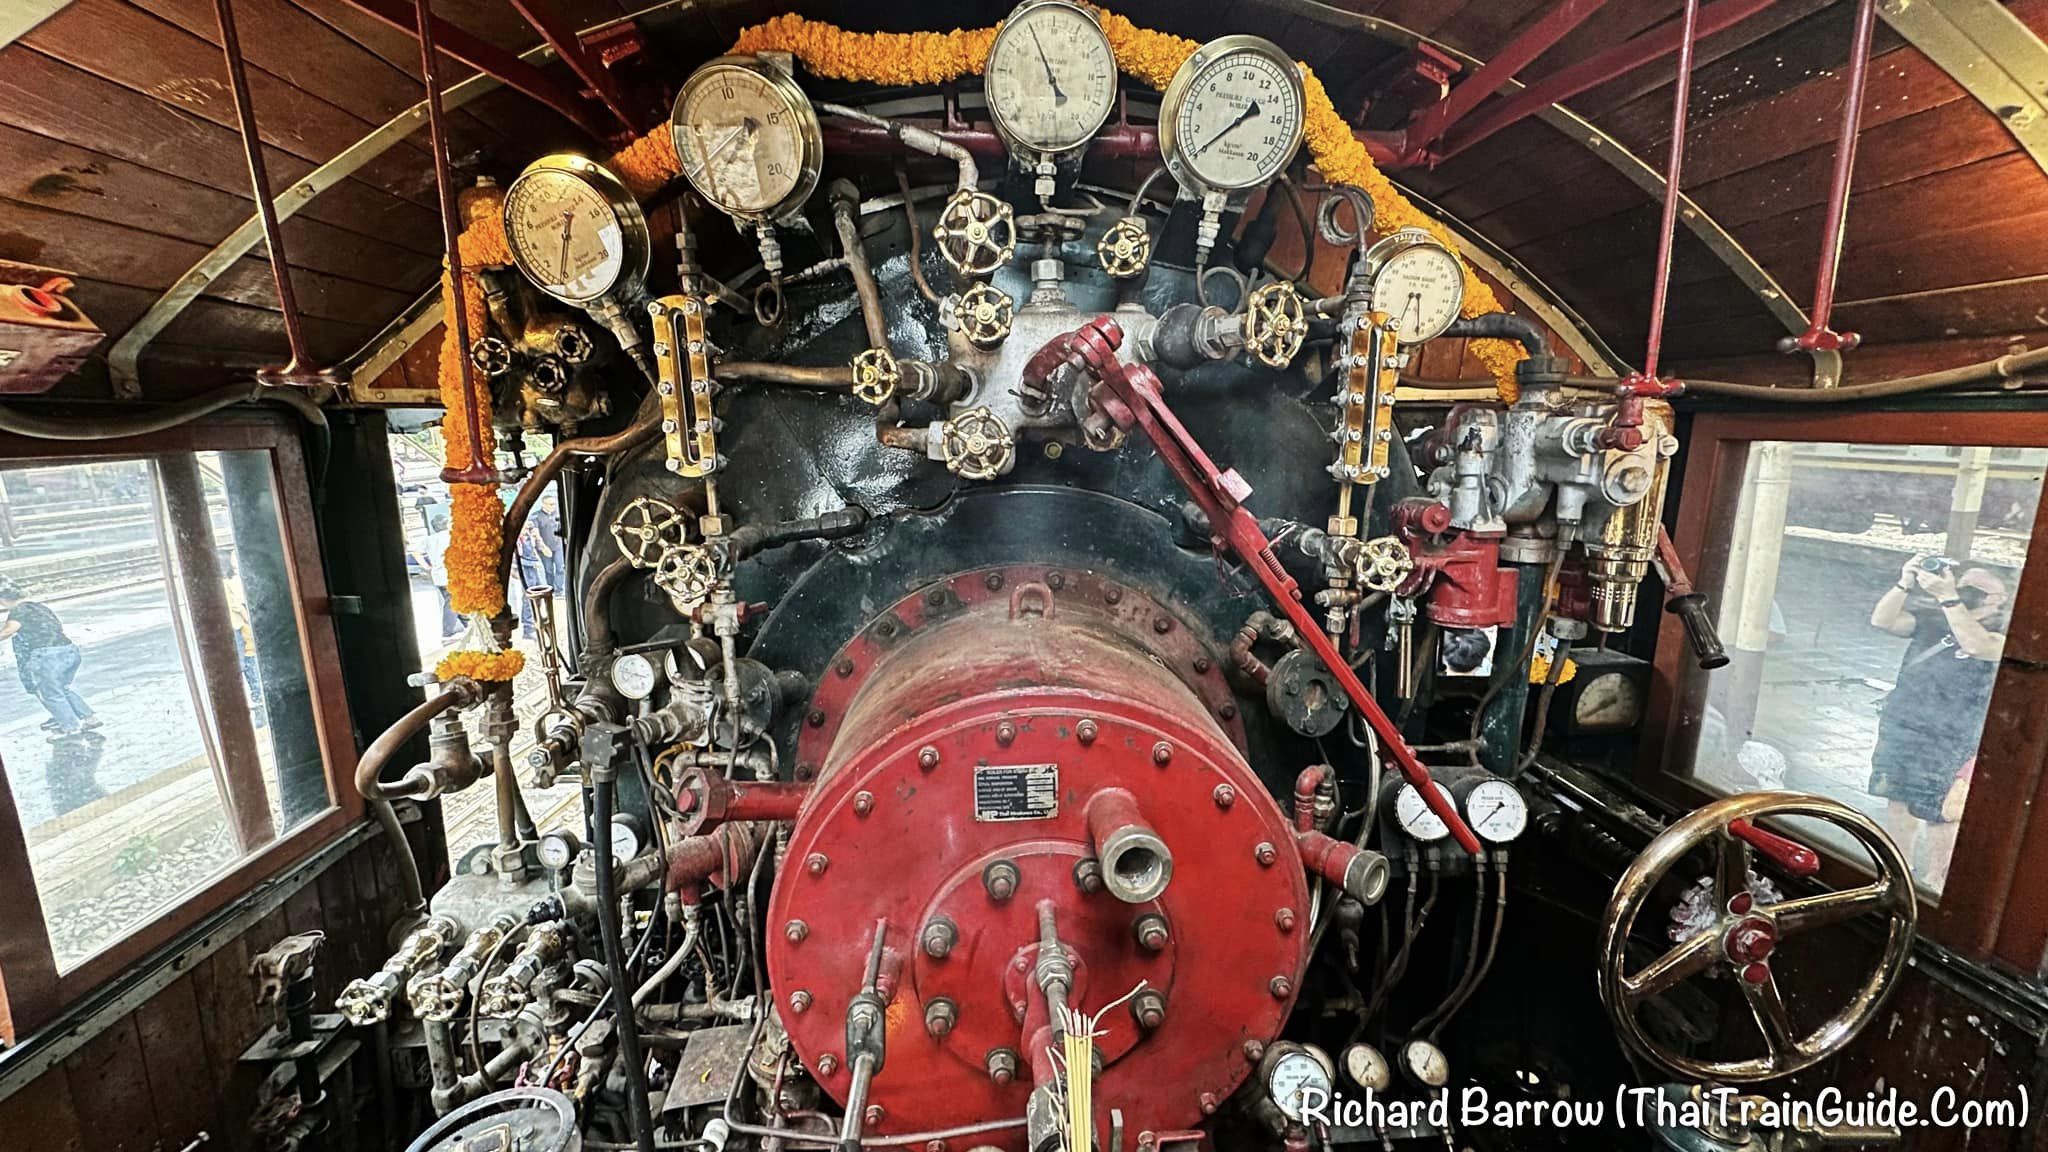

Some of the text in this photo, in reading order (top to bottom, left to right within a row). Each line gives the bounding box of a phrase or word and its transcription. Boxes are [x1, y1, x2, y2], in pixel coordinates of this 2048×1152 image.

[1226, 72, 1233, 82] 8
[1243, 71, 1255, 80] 10
[1210, 83, 1216, 92] 6
[1259, 80, 1271, 89] 12
[721, 87, 734, 100] 10
[1267, 95, 1279, 104] 14
[1196, 103, 1202, 111] 4
[766, 112, 779, 125] 15
[1270, 115, 1282, 125] 16
[1194, 125, 1200, 133] 2
[1263, 136, 1275, 146] 18
[1247, 152, 1258, 161] 20
[768, 163, 783, 176] 20
[573, 195, 584, 206] 14
[530, 204, 537, 213] 8
[589, 208, 600, 220] 16
[526, 220, 533, 230] 6
[598, 249, 609, 260] 20
